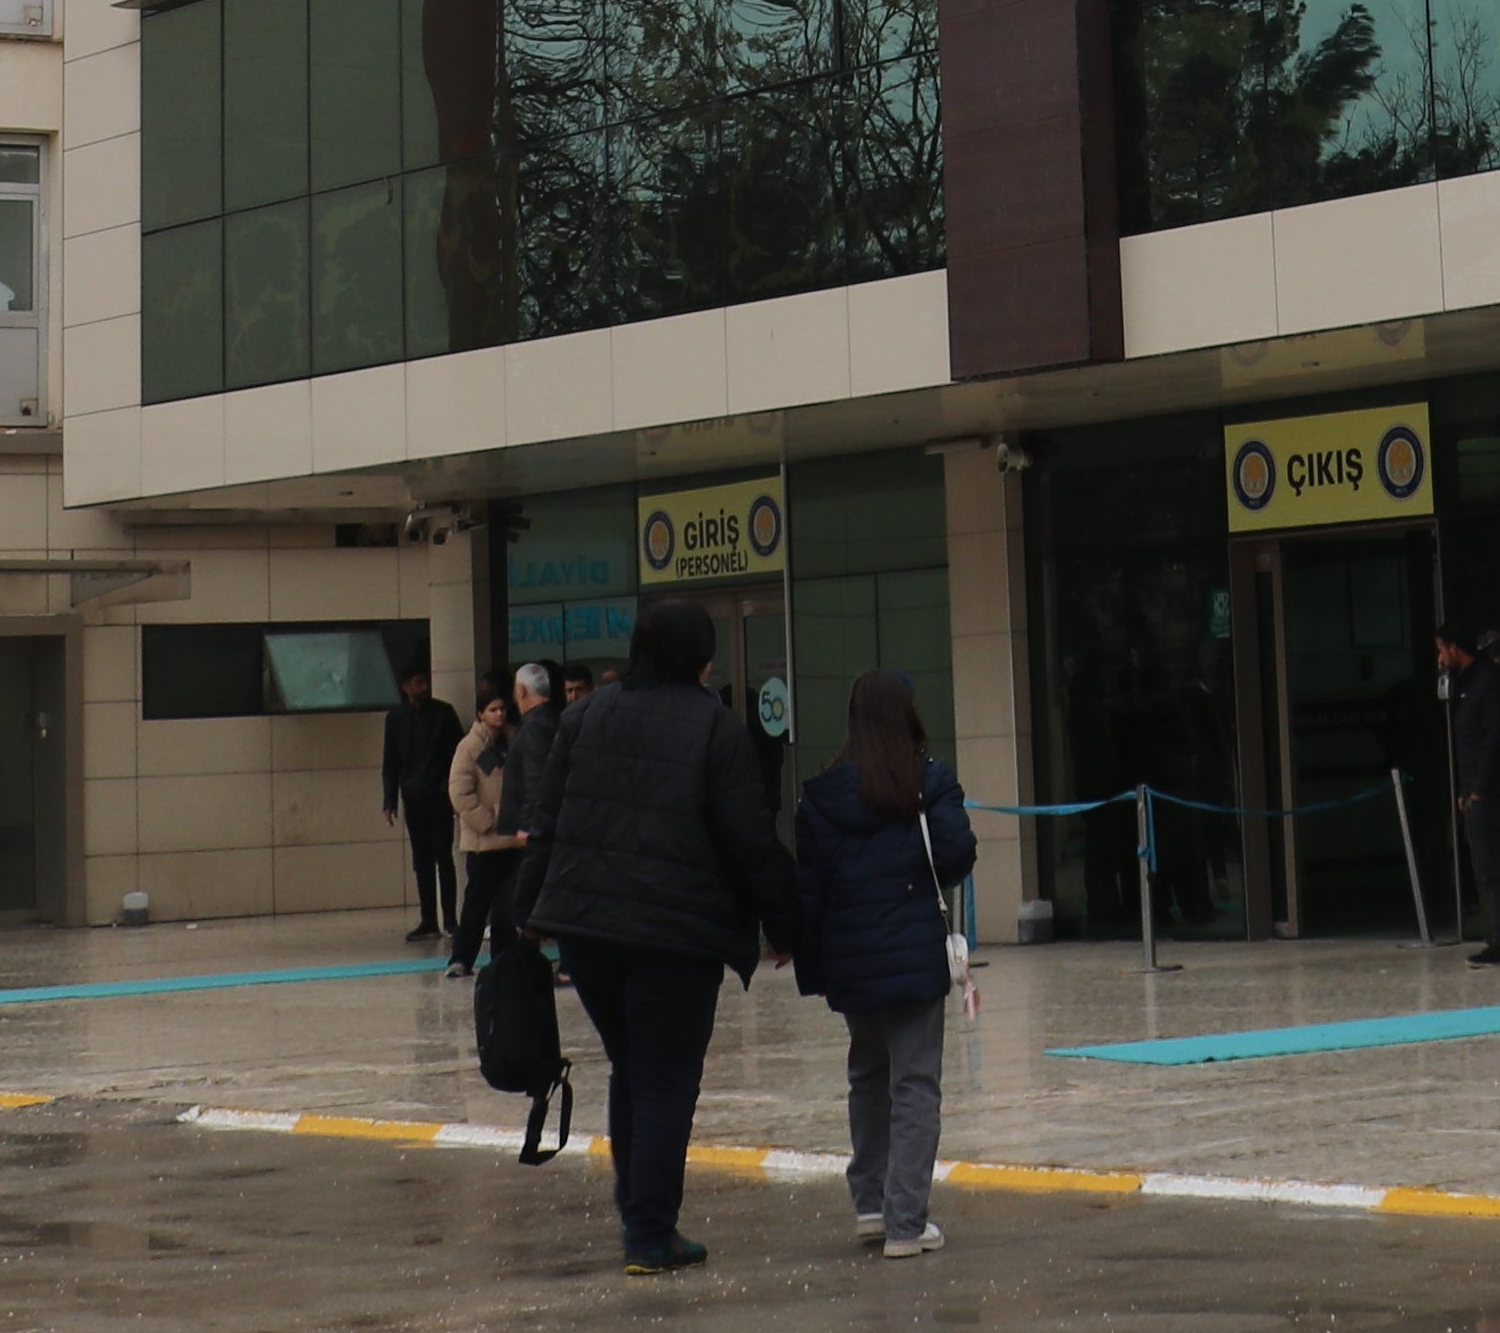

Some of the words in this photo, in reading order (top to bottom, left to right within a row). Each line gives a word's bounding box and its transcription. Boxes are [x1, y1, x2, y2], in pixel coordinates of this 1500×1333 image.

[1286, 448, 1364, 497] ÇIKIŞ
[683, 508, 740, 553] GİRİŞ
[676, 550, 748, 577] (PERSONEL)
